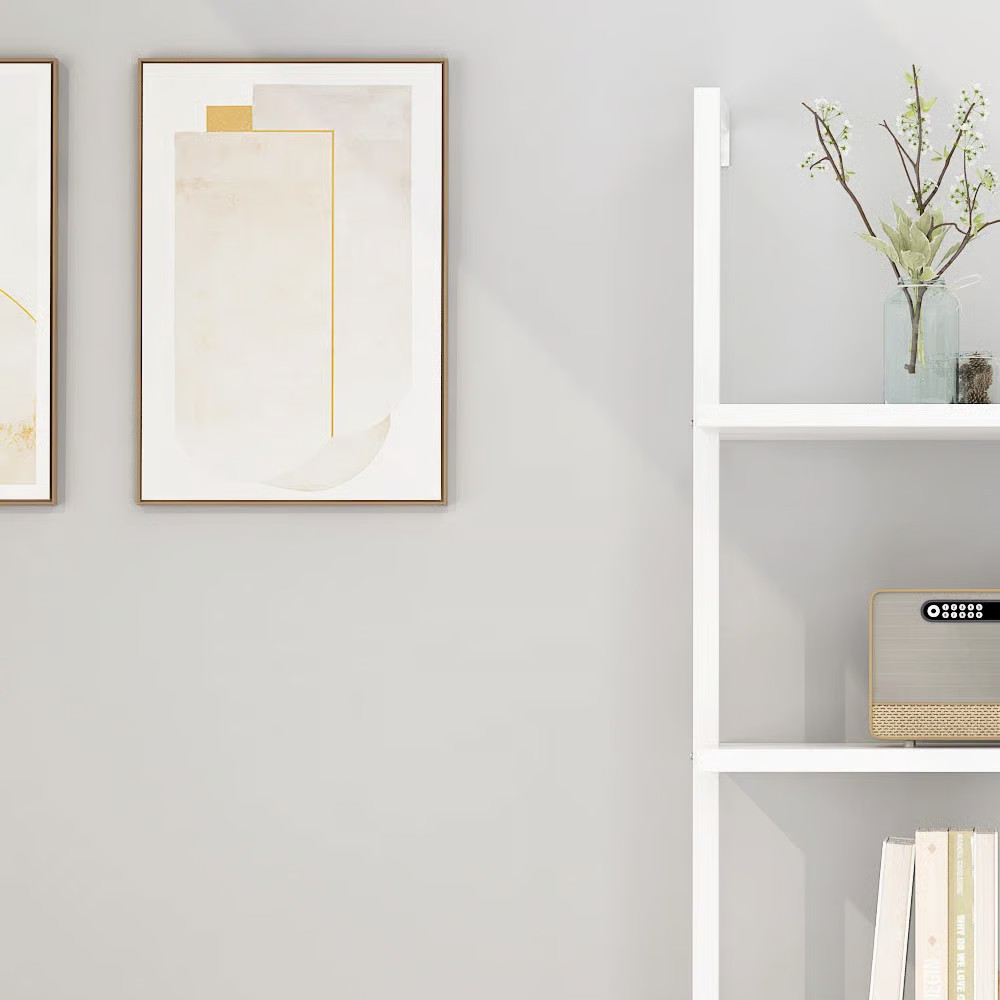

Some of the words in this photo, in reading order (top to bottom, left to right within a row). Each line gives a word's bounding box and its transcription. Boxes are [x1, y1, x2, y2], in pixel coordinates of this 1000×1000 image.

[957, 914, 966, 936] WHY
[957, 938, 966, 950] DO
[957, 953, 966, 967] WE
[957, 969, 966, 992] LOVE
